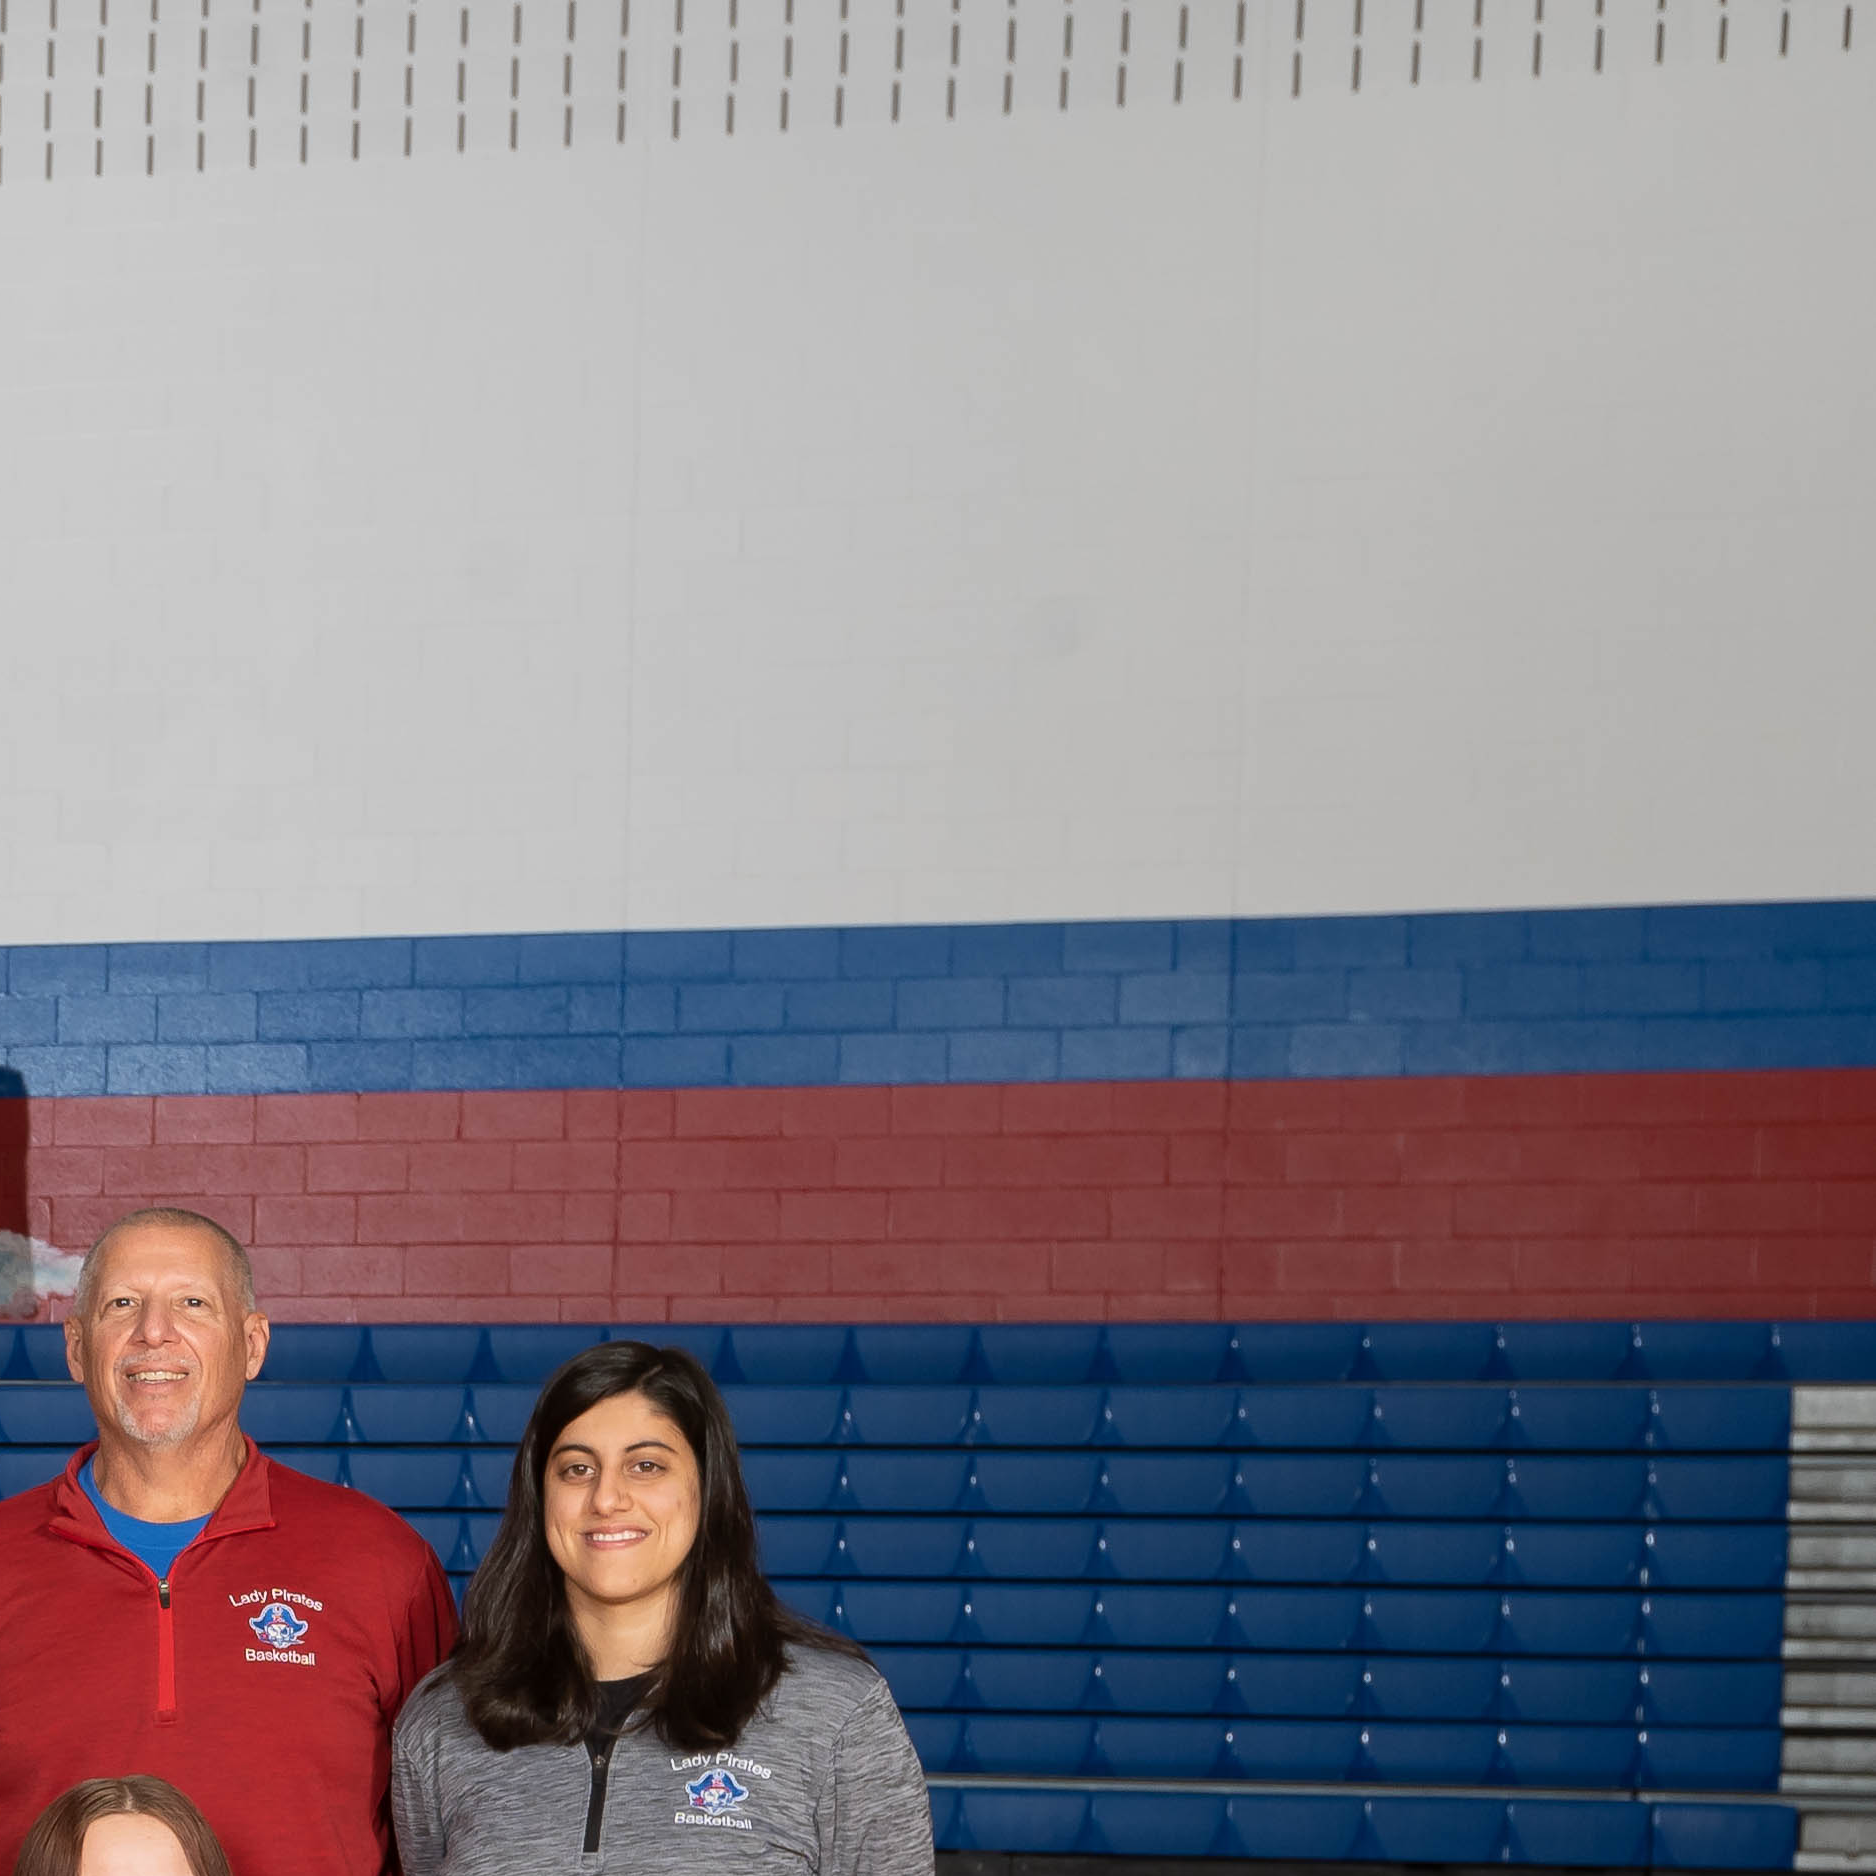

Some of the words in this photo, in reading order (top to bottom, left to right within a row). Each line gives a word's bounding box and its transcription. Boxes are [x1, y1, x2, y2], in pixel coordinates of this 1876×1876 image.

[228, 1589, 268, 1607] Lady
[271, 1588, 324, 1612] Pirates
[244, 1648, 316, 1667] Basketball
[670, 1753, 712, 1772] Lady
[715, 1752, 772, 1780] Pirates
[674, 1811, 753, 1830] Basketball
